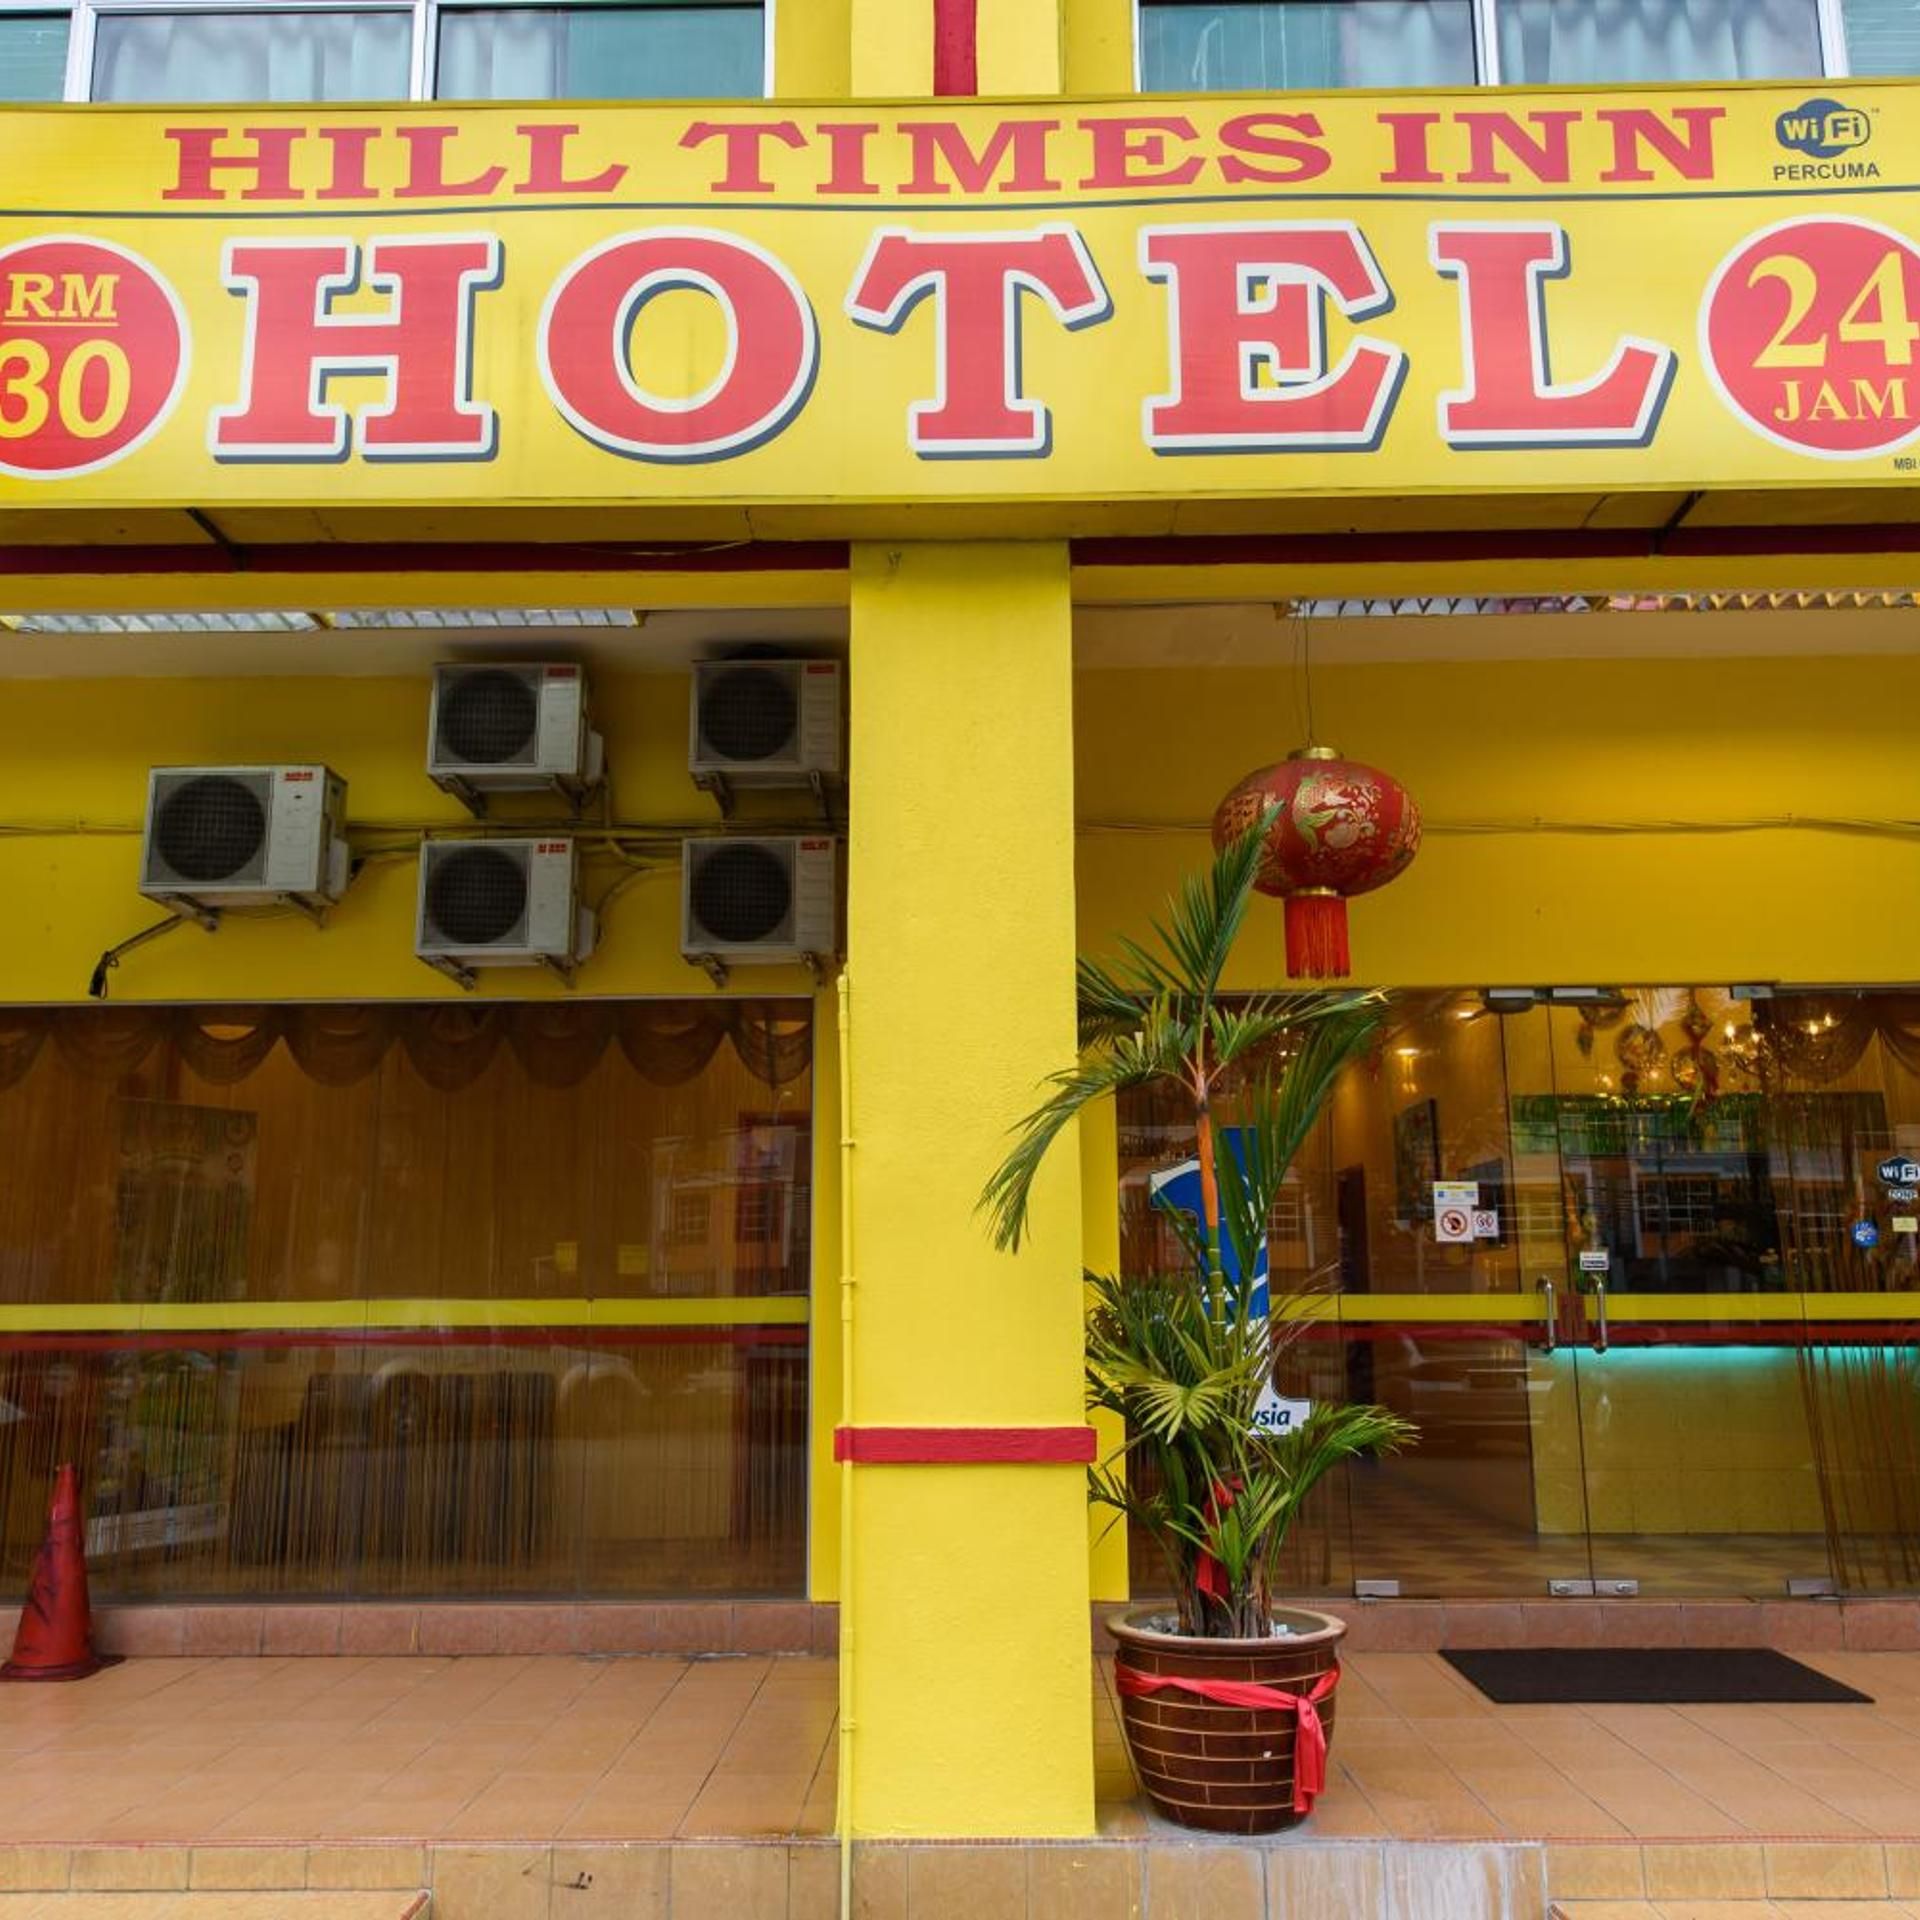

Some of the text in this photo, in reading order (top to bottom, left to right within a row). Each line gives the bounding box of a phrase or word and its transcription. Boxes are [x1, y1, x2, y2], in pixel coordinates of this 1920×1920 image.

[162, 108, 1725, 201] HILL TIMES INN
[1773, 163, 1880, 180] PERCUMA
[4, 273, 119, 318] RM
[209, 221, 1677, 463] HOTEL
[1747, 251, 1920, 369] 24
[0, 338, 132, 439] 30
[1774, 378, 1907, 422] JAM
